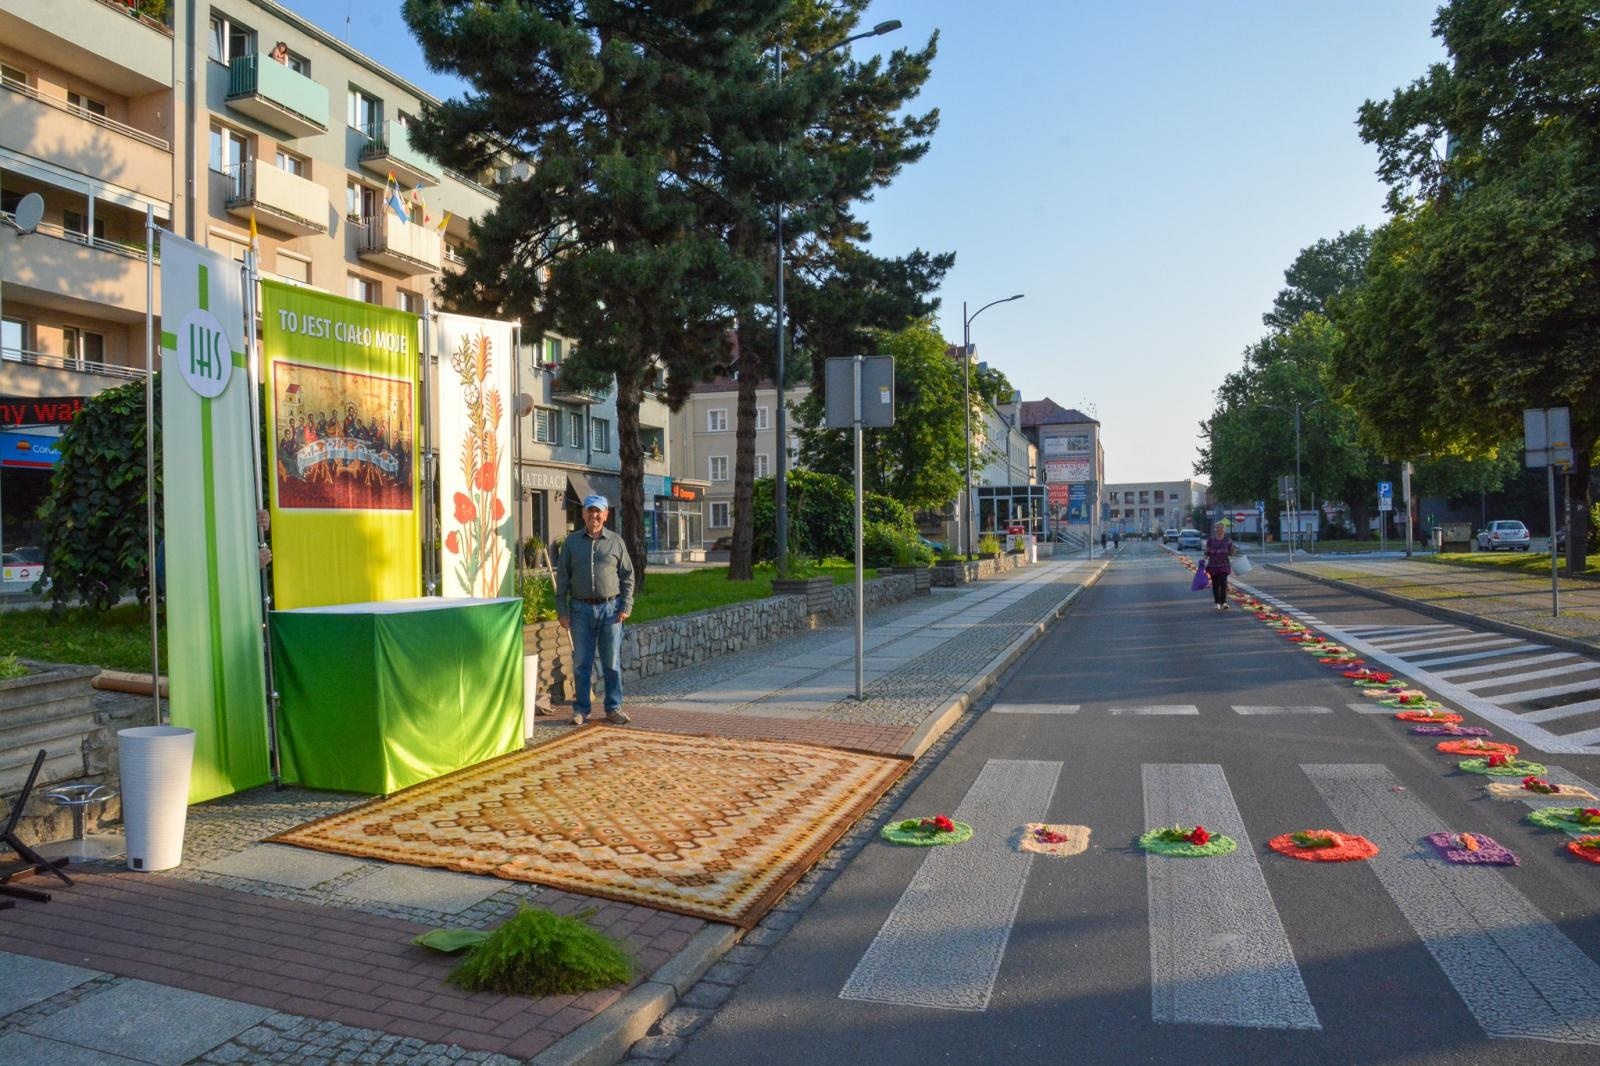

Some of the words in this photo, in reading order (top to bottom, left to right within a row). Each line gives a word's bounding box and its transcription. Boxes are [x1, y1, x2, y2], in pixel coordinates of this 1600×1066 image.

[190, 323, 222, 381] IHS
[278, 309, 298, 333] TO
[300, 314, 332, 339] JEST
[334, 321, 372, 347] CIAŁO
[375, 329, 408, 354] MOJE
[514, 467, 567, 490] MATERACE
